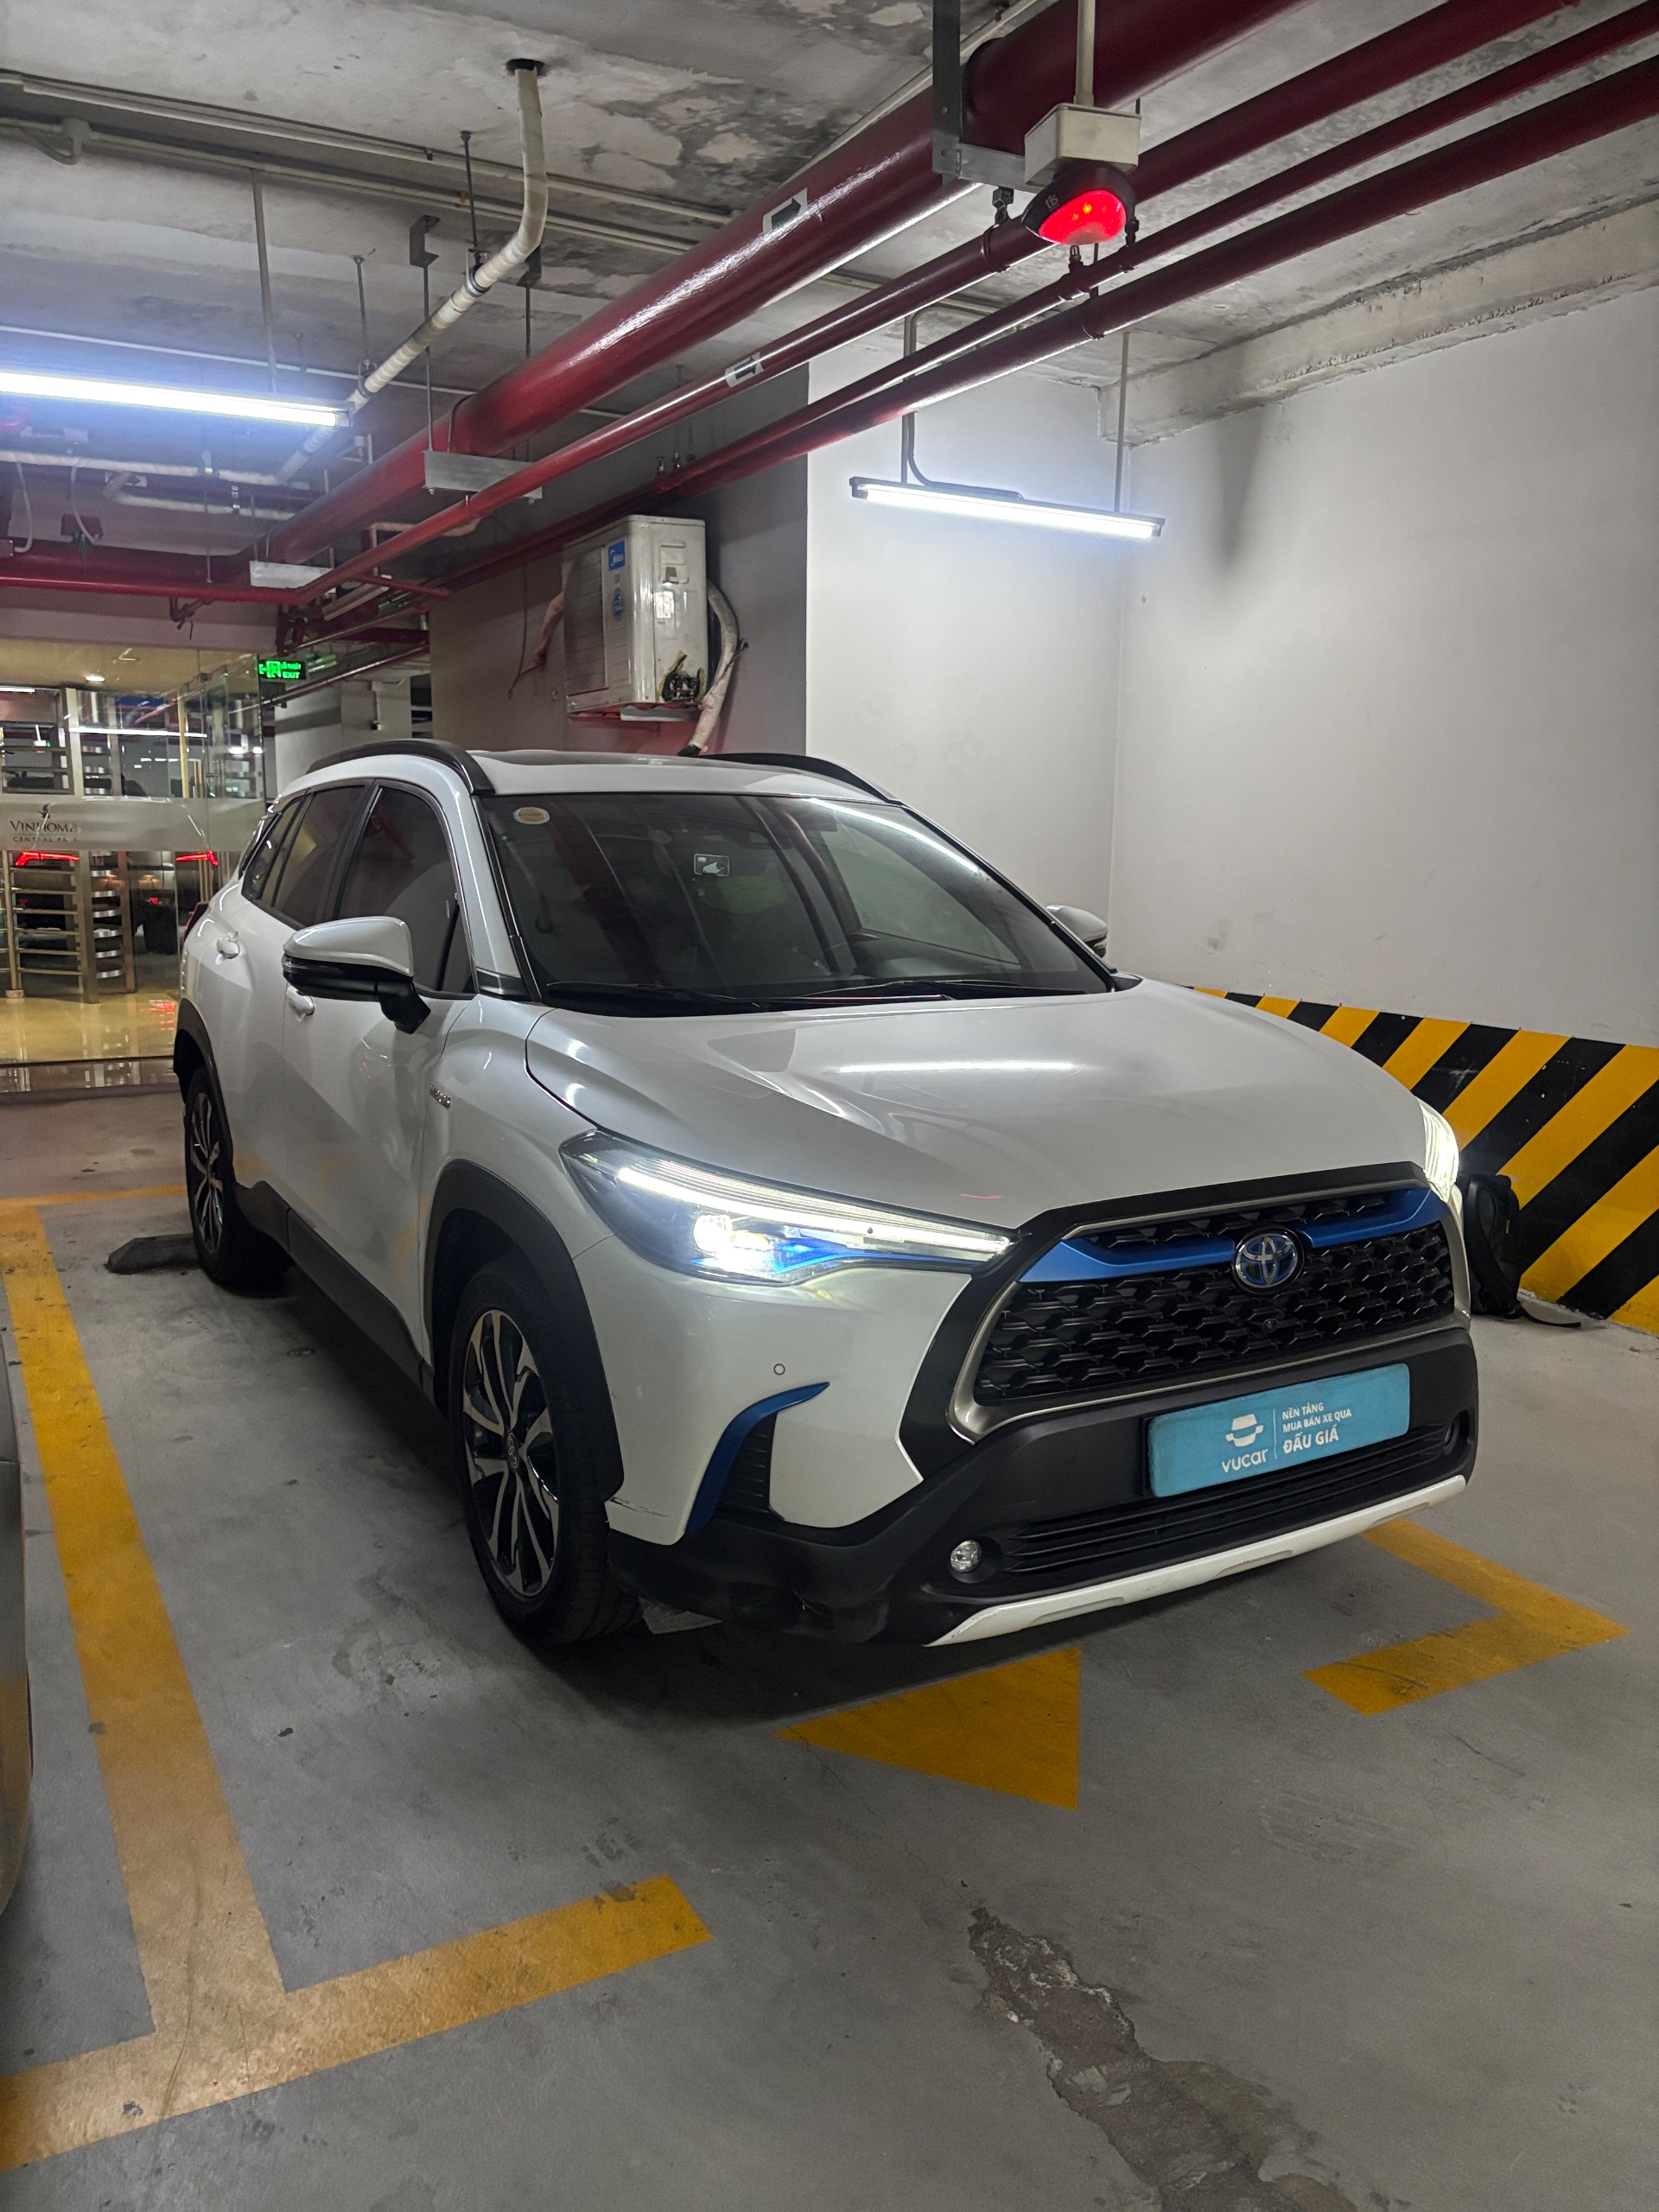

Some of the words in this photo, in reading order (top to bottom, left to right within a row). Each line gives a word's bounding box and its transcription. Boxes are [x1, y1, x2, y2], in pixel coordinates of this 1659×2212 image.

[1281, 1407, 1300, 1420] NỀN
[1301, 1402, 1325, 1417] TẢNG
[1282, 1421, 1302, 1433] MUA
[1303, 1414, 1321, 1428] BÁN
[1322, 1413, 1333, 1424] XE
[1334, 1408, 1352, 1422] QUA
[1282, 1431, 1312, 1454] ĐẤU
[1315, 1424, 1339, 1446] GIÁ
[1221, 1448, 1268, 1473] vucar
